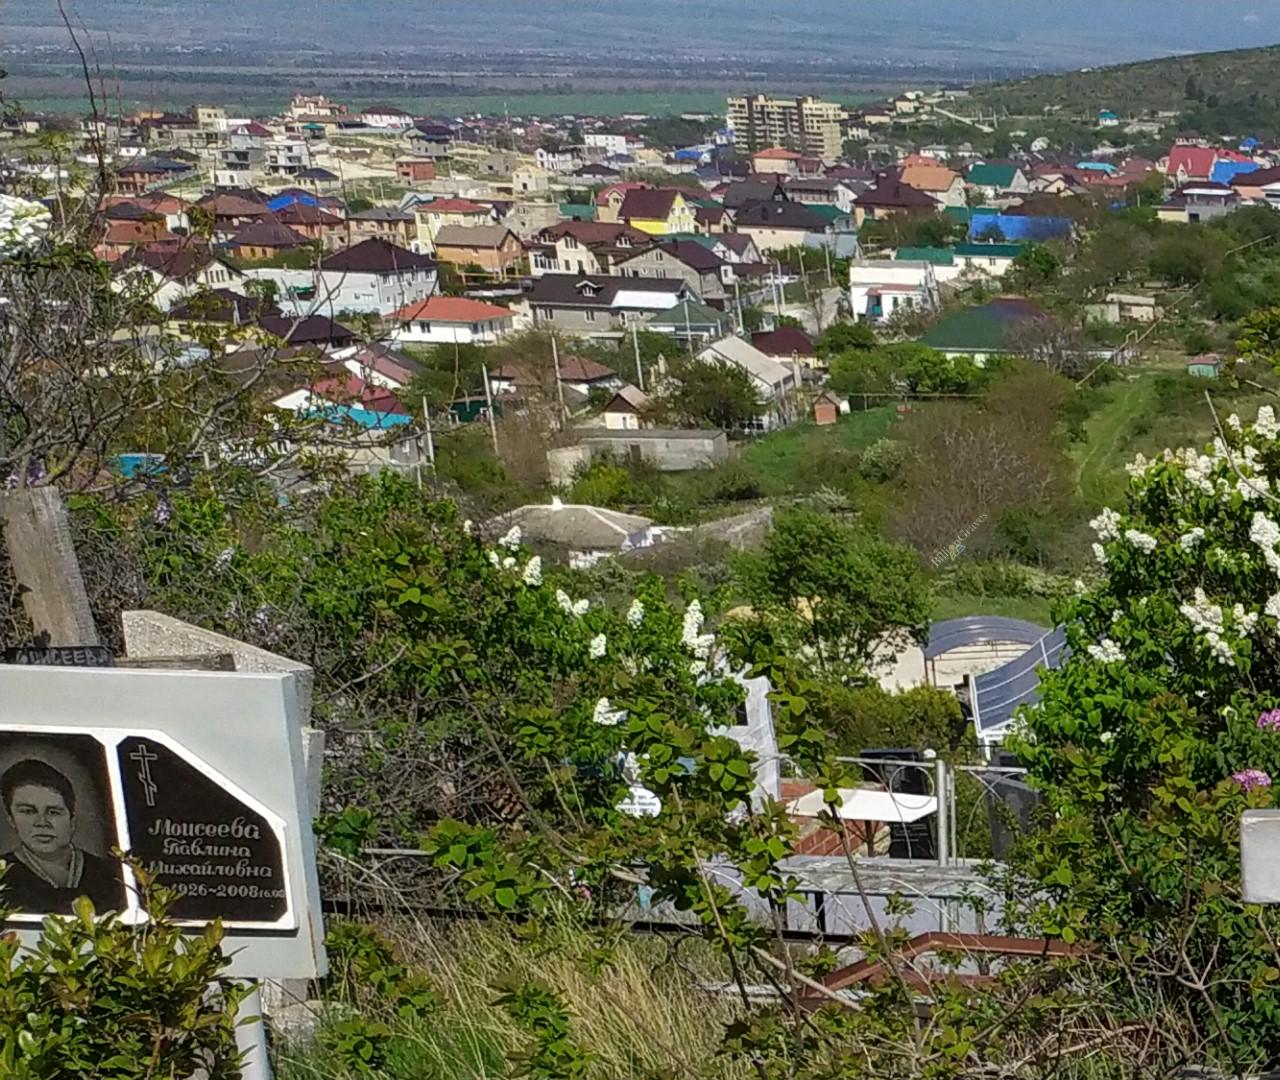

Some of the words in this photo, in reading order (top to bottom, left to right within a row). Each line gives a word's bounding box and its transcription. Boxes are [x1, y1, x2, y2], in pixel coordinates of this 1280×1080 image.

[148, 816, 262, 840] Моисеева
[163, 837, 251, 858] Павлина
[145, 859, 273, 881] Михайловна
